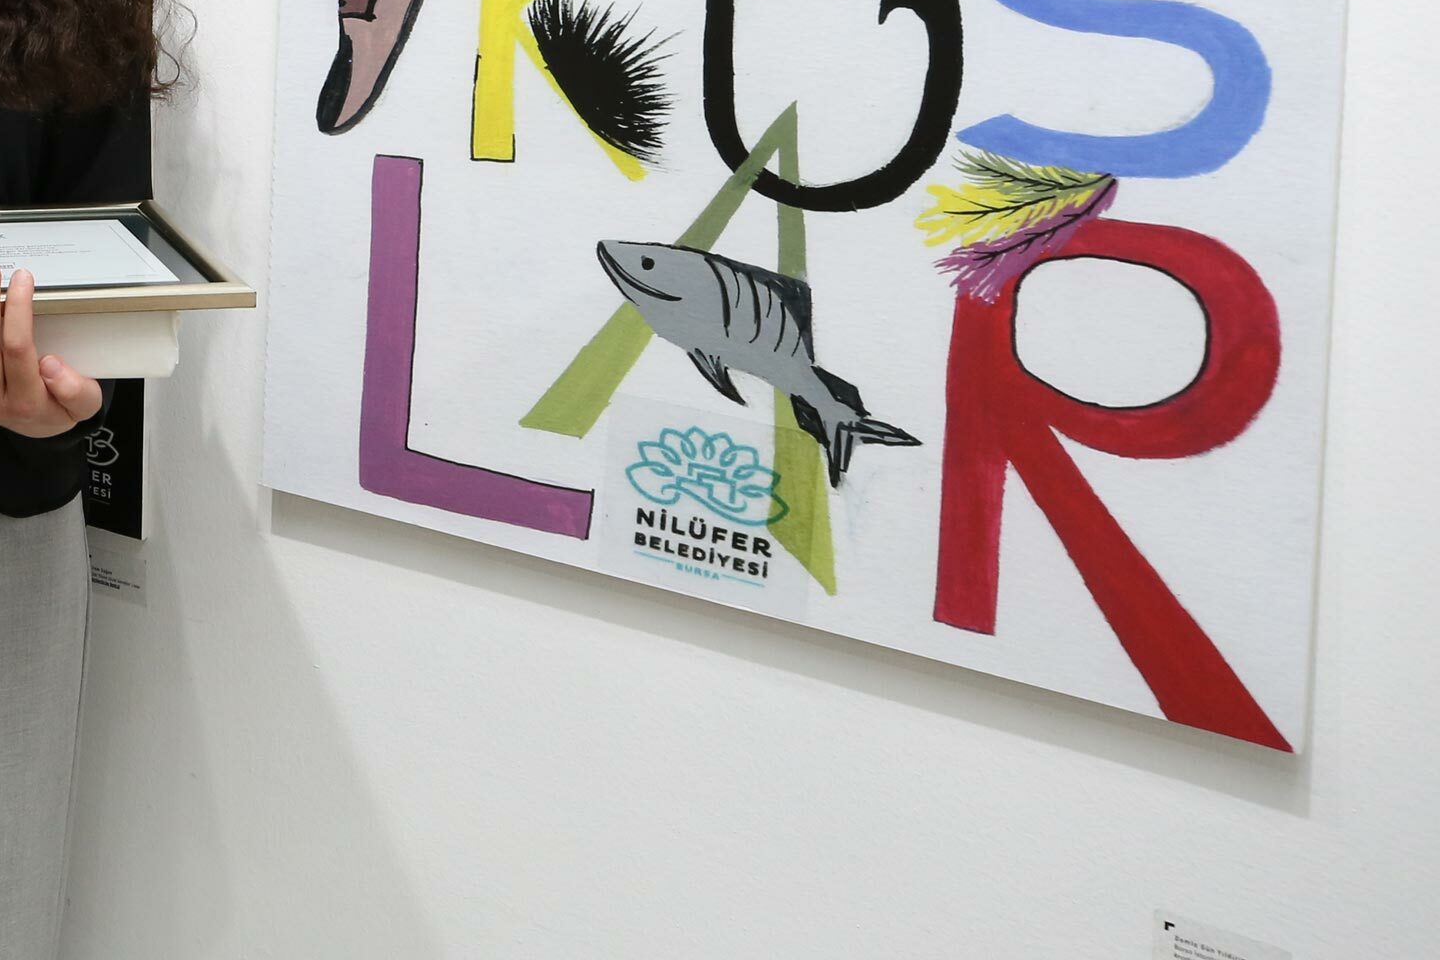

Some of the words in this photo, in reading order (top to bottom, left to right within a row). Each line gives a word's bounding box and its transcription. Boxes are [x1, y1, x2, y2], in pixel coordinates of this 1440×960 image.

[359, 101, 1294, 753] LAR
[634, 531, 768, 579] BELEDİYESİ
[636, 507, 772, 558] NİLÜFER
[675, 562, 720, 581] BURSA
